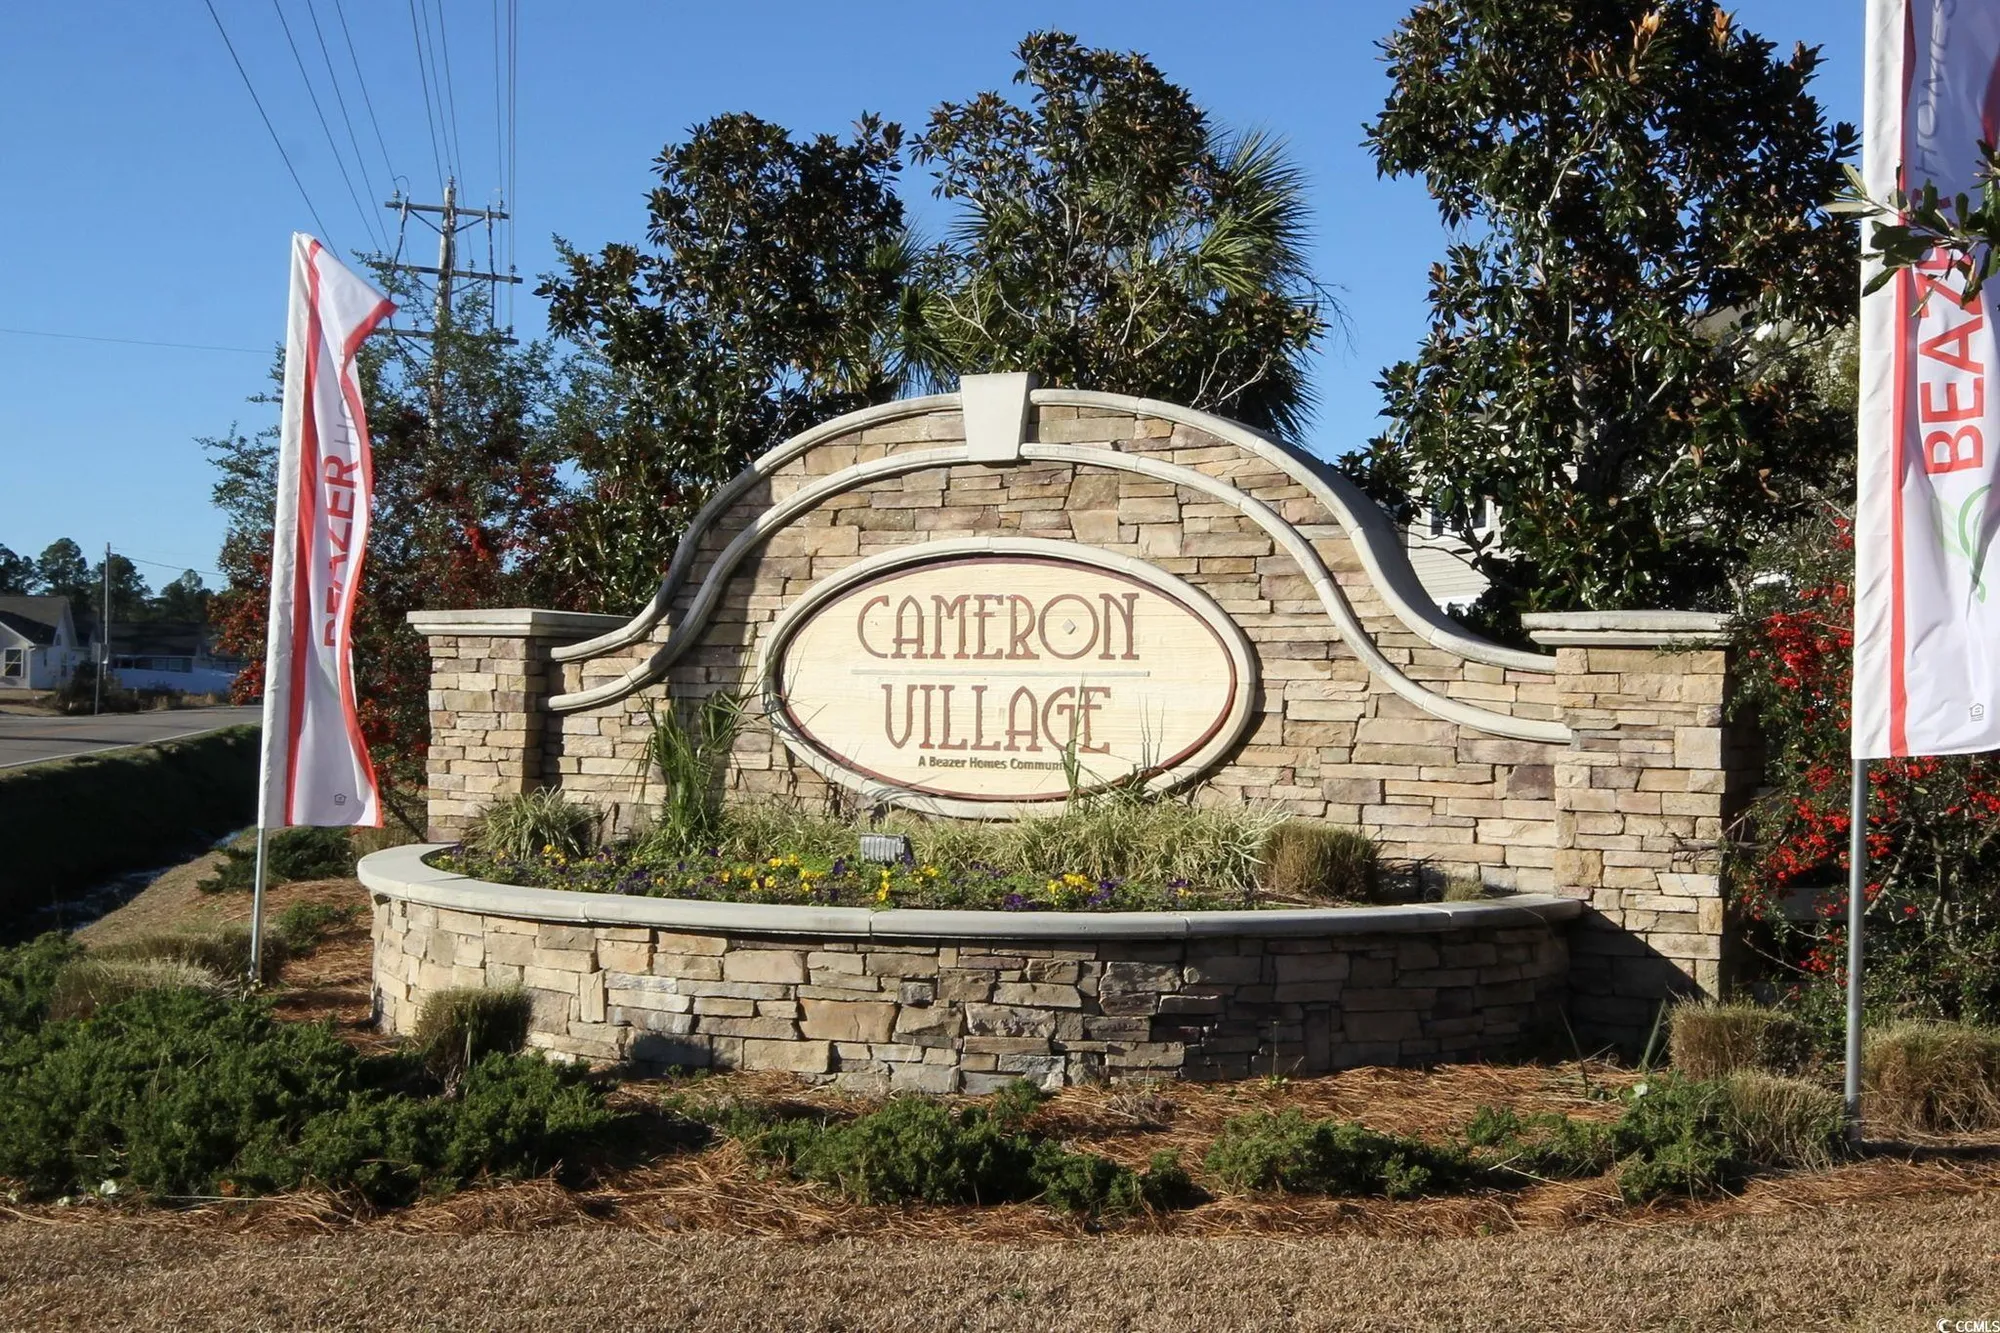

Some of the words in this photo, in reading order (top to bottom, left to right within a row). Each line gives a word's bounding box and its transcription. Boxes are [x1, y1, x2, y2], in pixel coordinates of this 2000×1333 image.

[856, 592, 1140, 661] CAMERON
[881, 684, 1112, 754] VILLAGE
[918, 756, 927, 767] A
[929, 756, 967, 769] Beazer
[969, 757, 1007, 770] Homes
[1009, 758, 1068, 771] Communi
